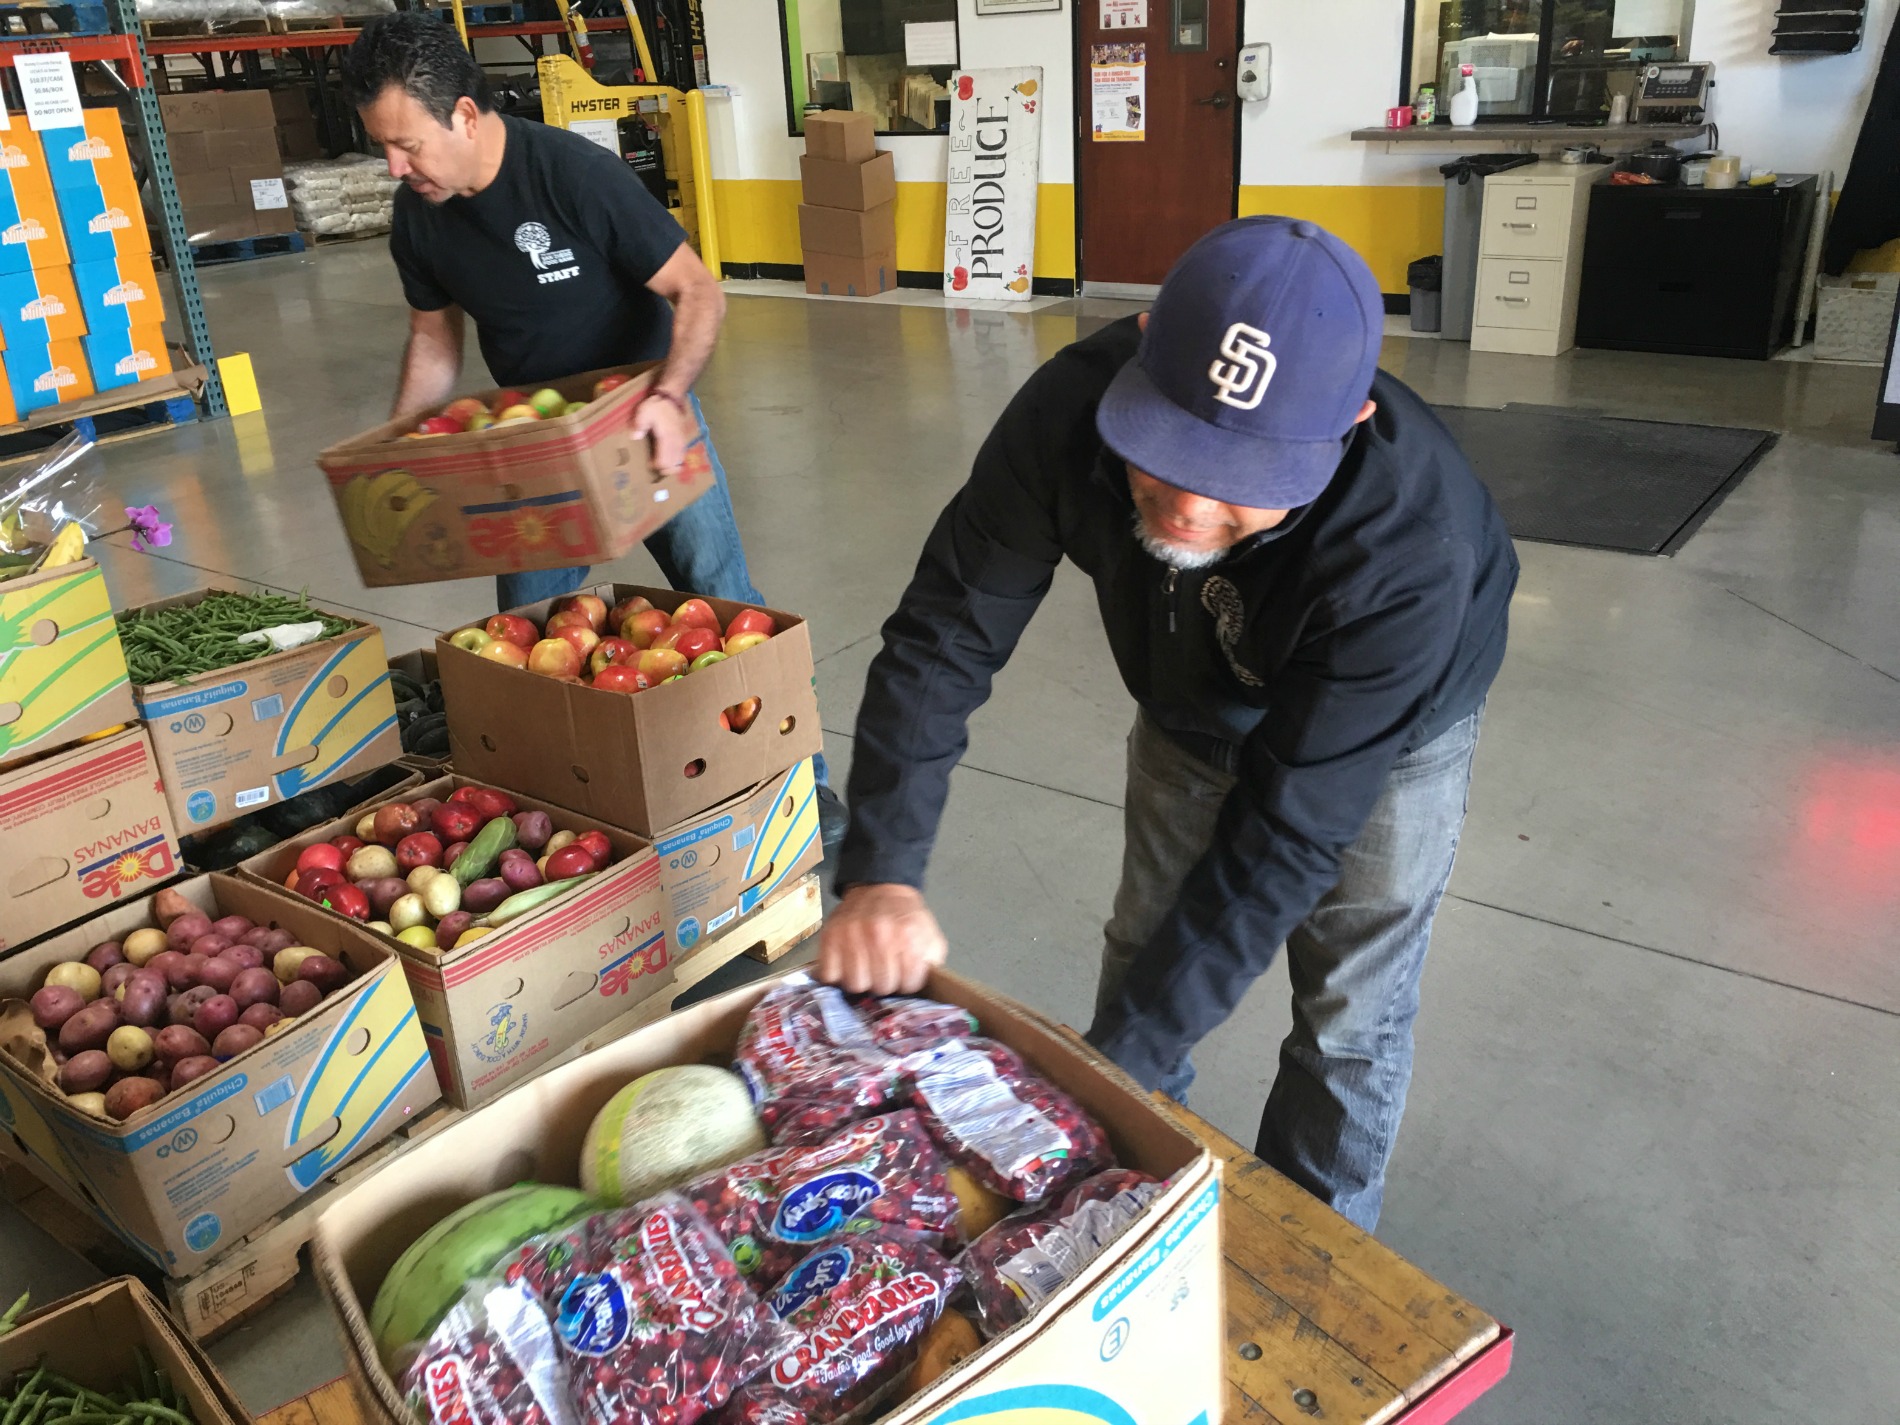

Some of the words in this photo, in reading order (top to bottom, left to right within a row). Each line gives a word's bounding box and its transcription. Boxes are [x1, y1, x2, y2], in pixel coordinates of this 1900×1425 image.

[571, 98, 620, 113] HYSTER
[949, 135, 972, 245] FREE
[971, 96, 1011, 280] PRODUCE
[89, 216, 132, 234] Millville
[2, 227, 48, 245] Millville
[537, 266, 580, 284] STAFF
[103, 288, 146, 307] Millville
[21, 303, 66, 321] Millville
[115, 357, 158, 376] Millville
[34, 373, 78, 392] Millville
[204, 683, 243, 700] Chiquita
[161, 694, 202, 710] Bananas
[700, 818, 730, 836] Chiquita
[74, 816, 161, 864] BANANAS
[662, 833, 696, 851] Bananas
[82, 841, 175, 899] Dole
[598, 911, 661, 960] BANANAS
[599, 937, 668, 997] Dole
[507, 1040, 521, 1055] WITH
[521, 1041, 549, 1062] PRODUCT
[472, 1066, 510, 1091] GUATEMALA
[196, 1077, 243, 1107] Chiquita
[139, 1107, 191, 1140] Bananas
[1100, 1247, 1160, 1310] Bananas
[874, 1327, 896, 1352] Good
[894, 1324, 907, 1342] for
